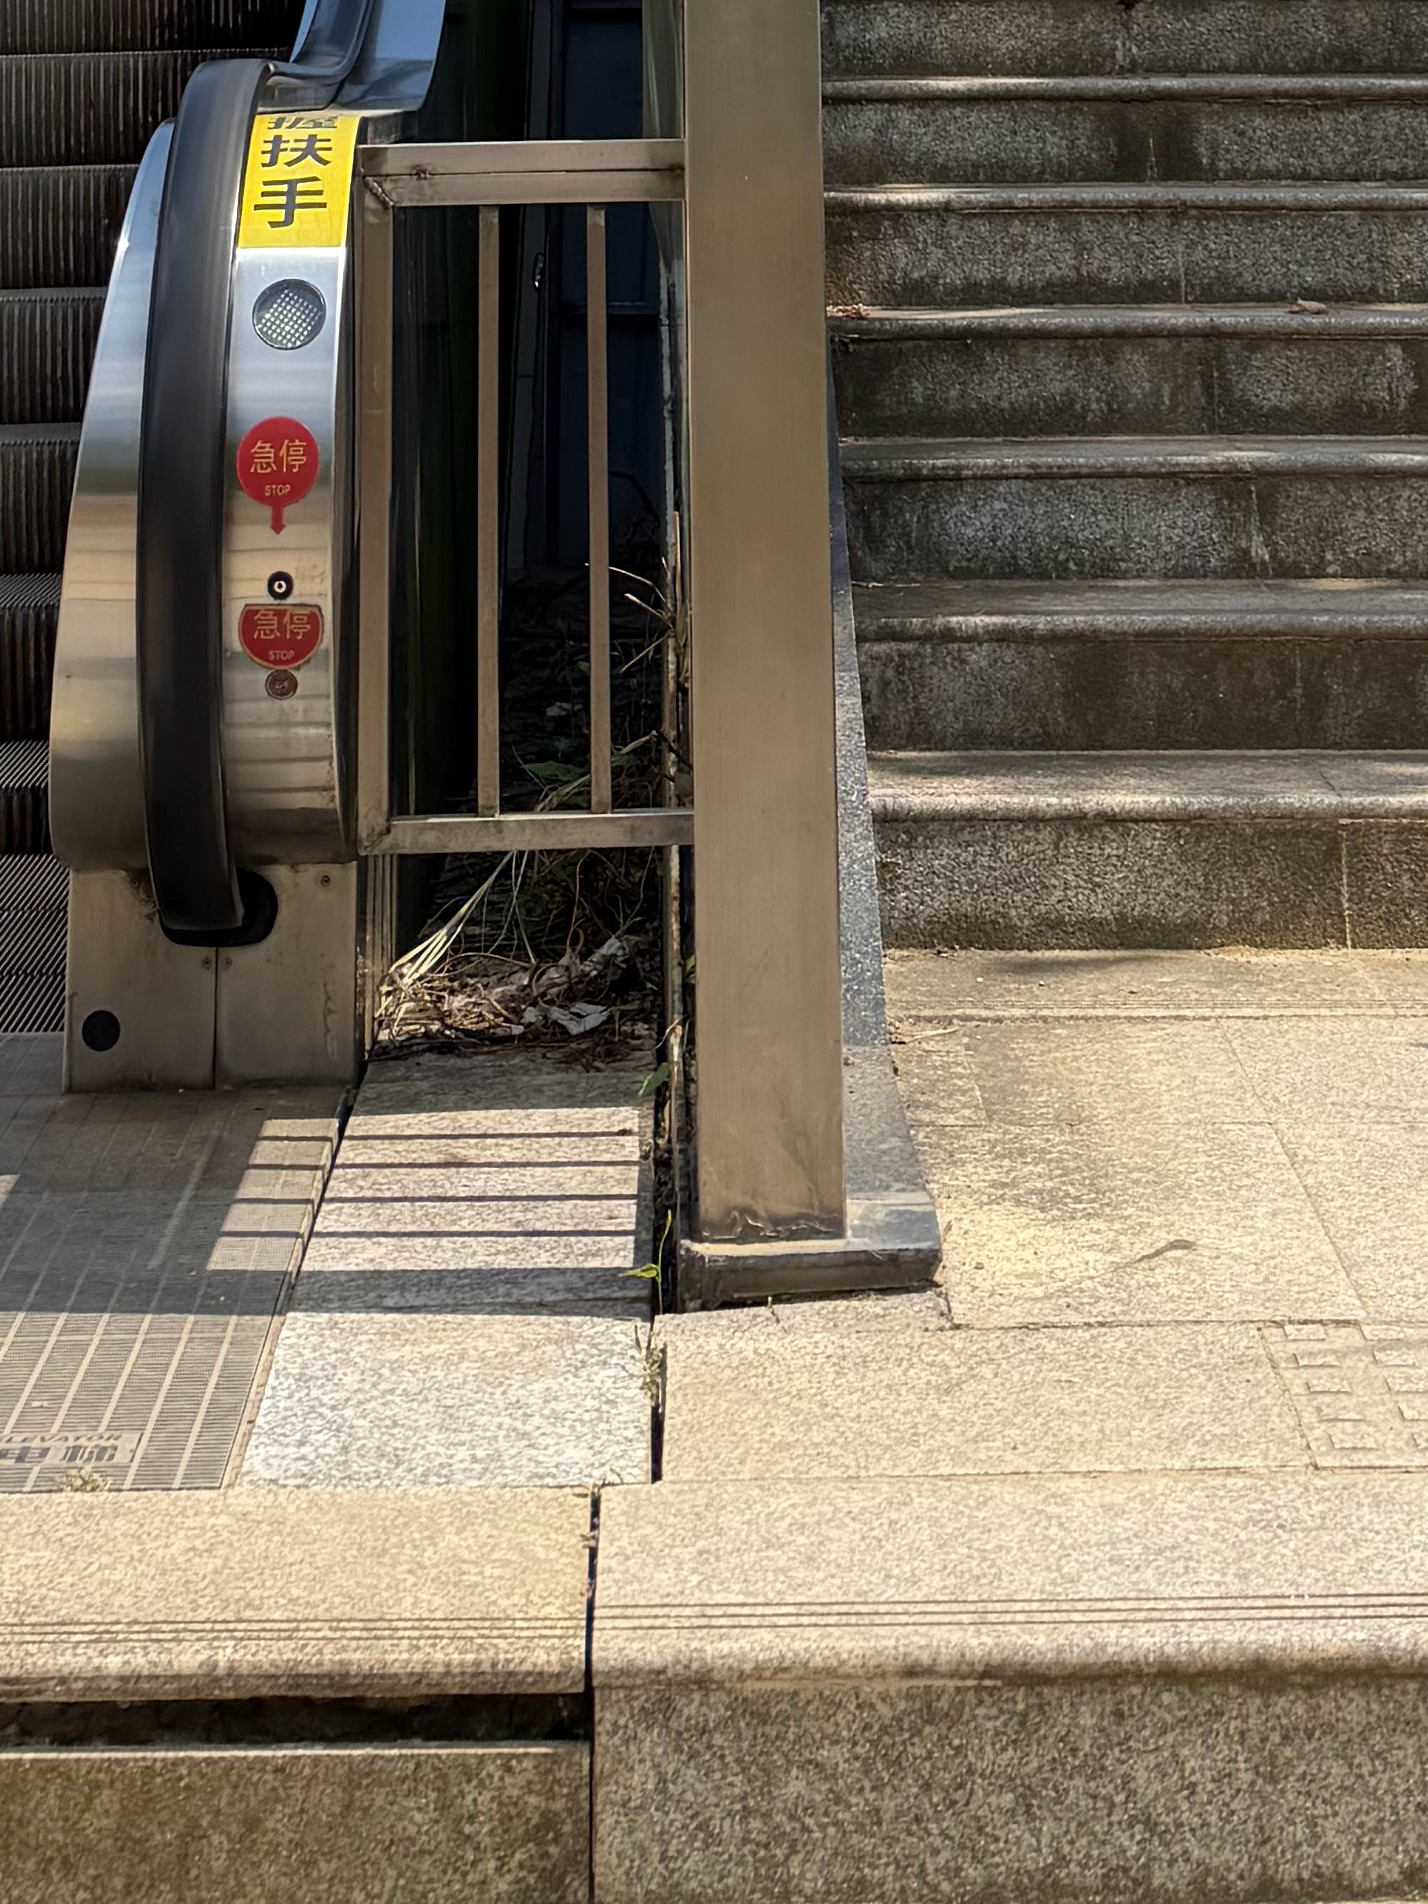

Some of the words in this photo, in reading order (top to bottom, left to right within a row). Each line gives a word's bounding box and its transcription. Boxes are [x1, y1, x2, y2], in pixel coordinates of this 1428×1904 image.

[250, 438, 308, 474] 急停
[264, 484, 292, 497] STOP
[254, 608, 312, 641] 急停
[268, 649, 295, 661] STOP
